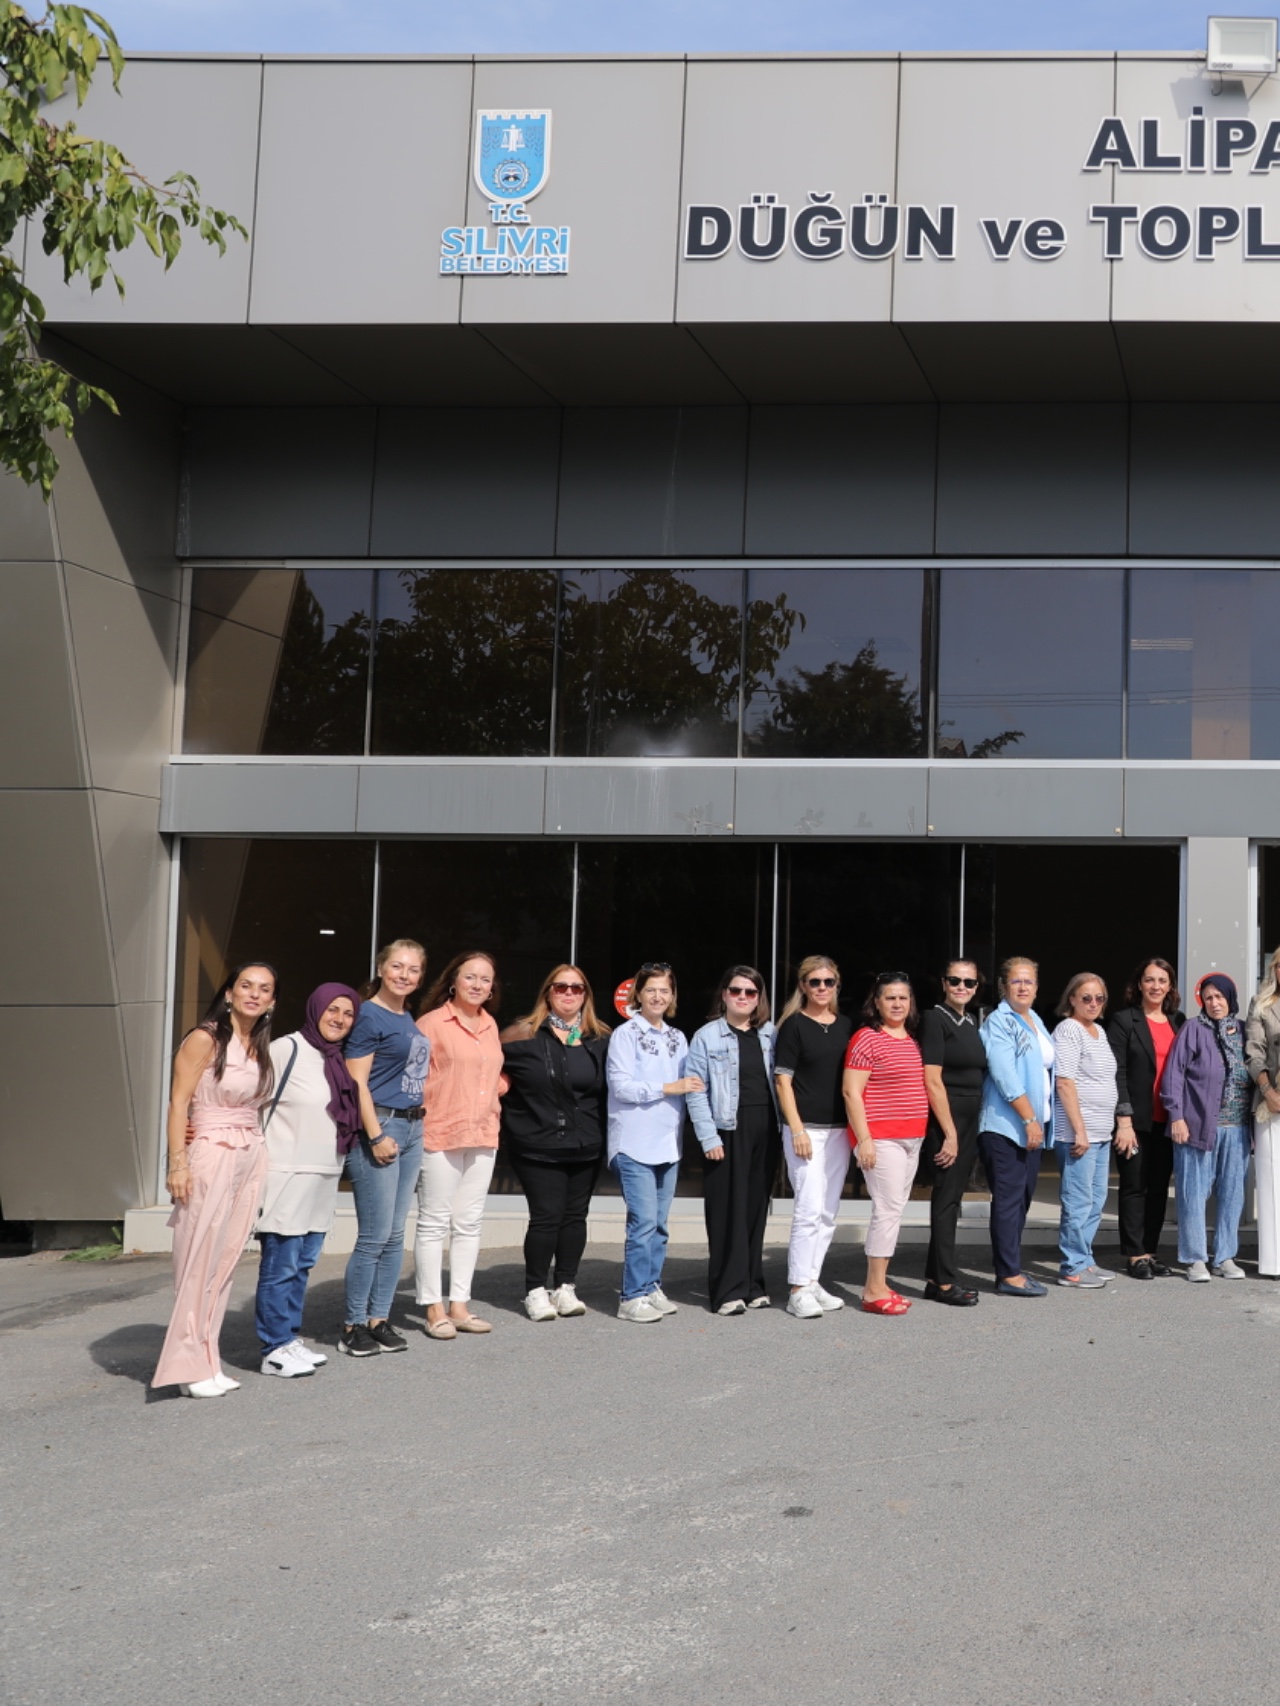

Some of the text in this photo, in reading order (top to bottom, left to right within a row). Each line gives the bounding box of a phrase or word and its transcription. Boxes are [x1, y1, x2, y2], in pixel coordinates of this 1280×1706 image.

[489, 203, 529, 222] T.C.
[685, 192, 956, 260] DÜĞÜN
[982, 217, 1066, 260] ve
